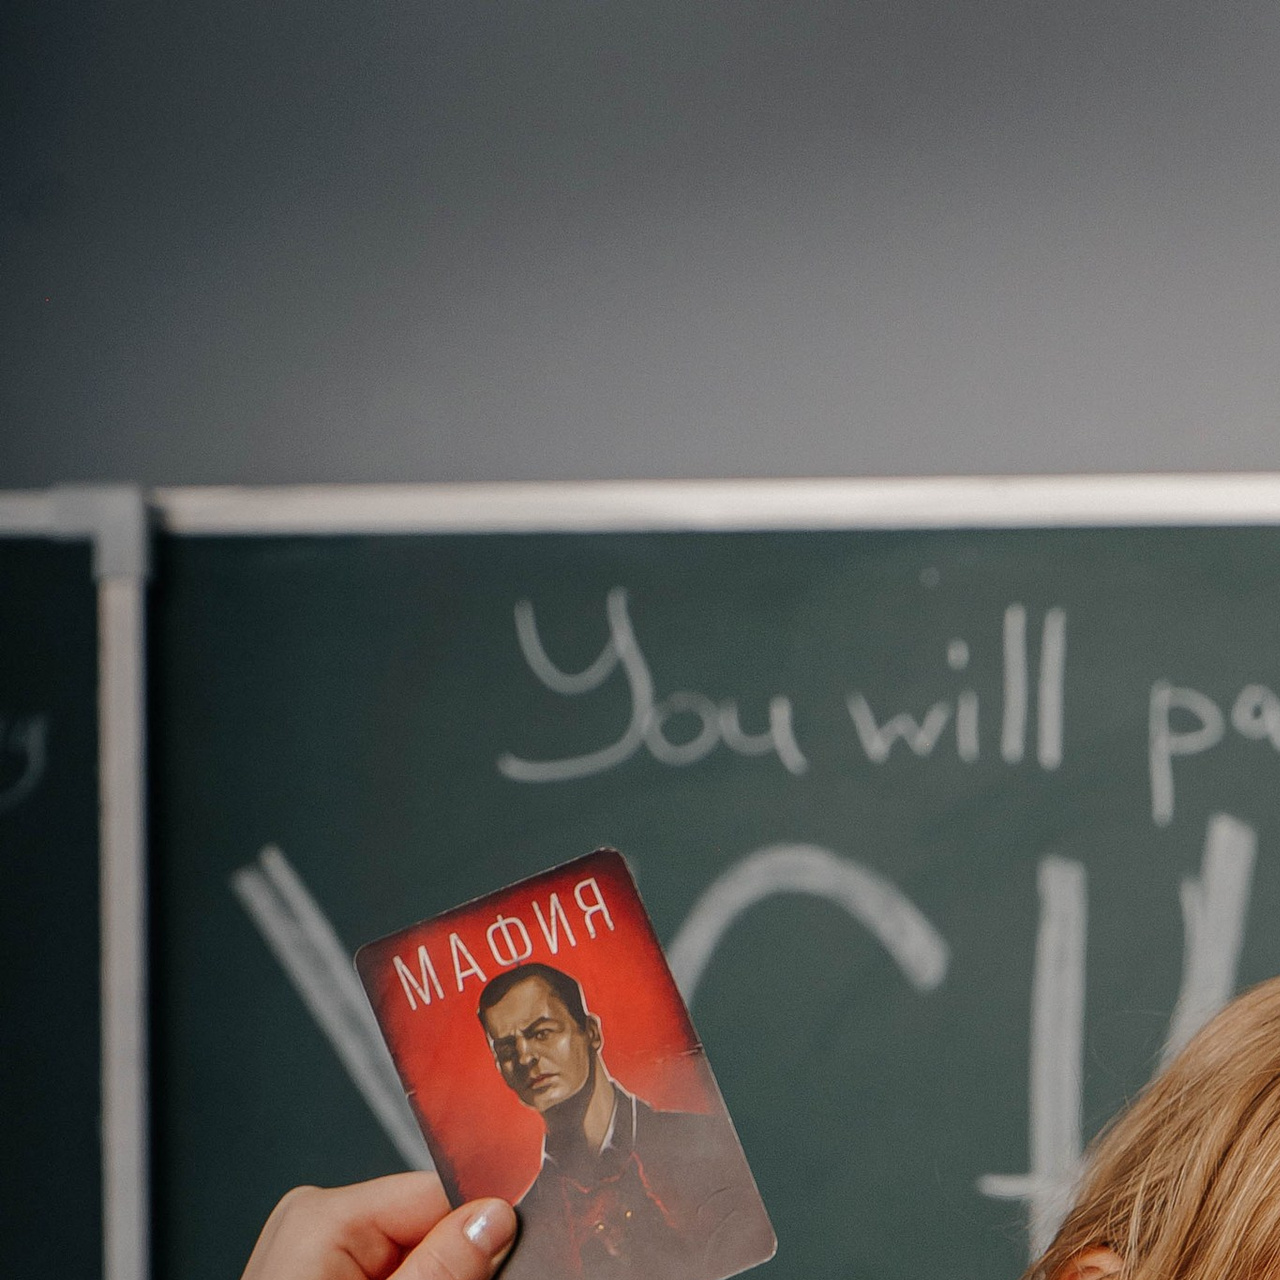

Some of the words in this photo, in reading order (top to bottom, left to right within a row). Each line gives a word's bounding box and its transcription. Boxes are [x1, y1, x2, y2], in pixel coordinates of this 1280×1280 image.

[496, 586, 808, 782] You
[845, 601, 1067, 770] will
[392, 876, 616, 1011] МАФИЯ
